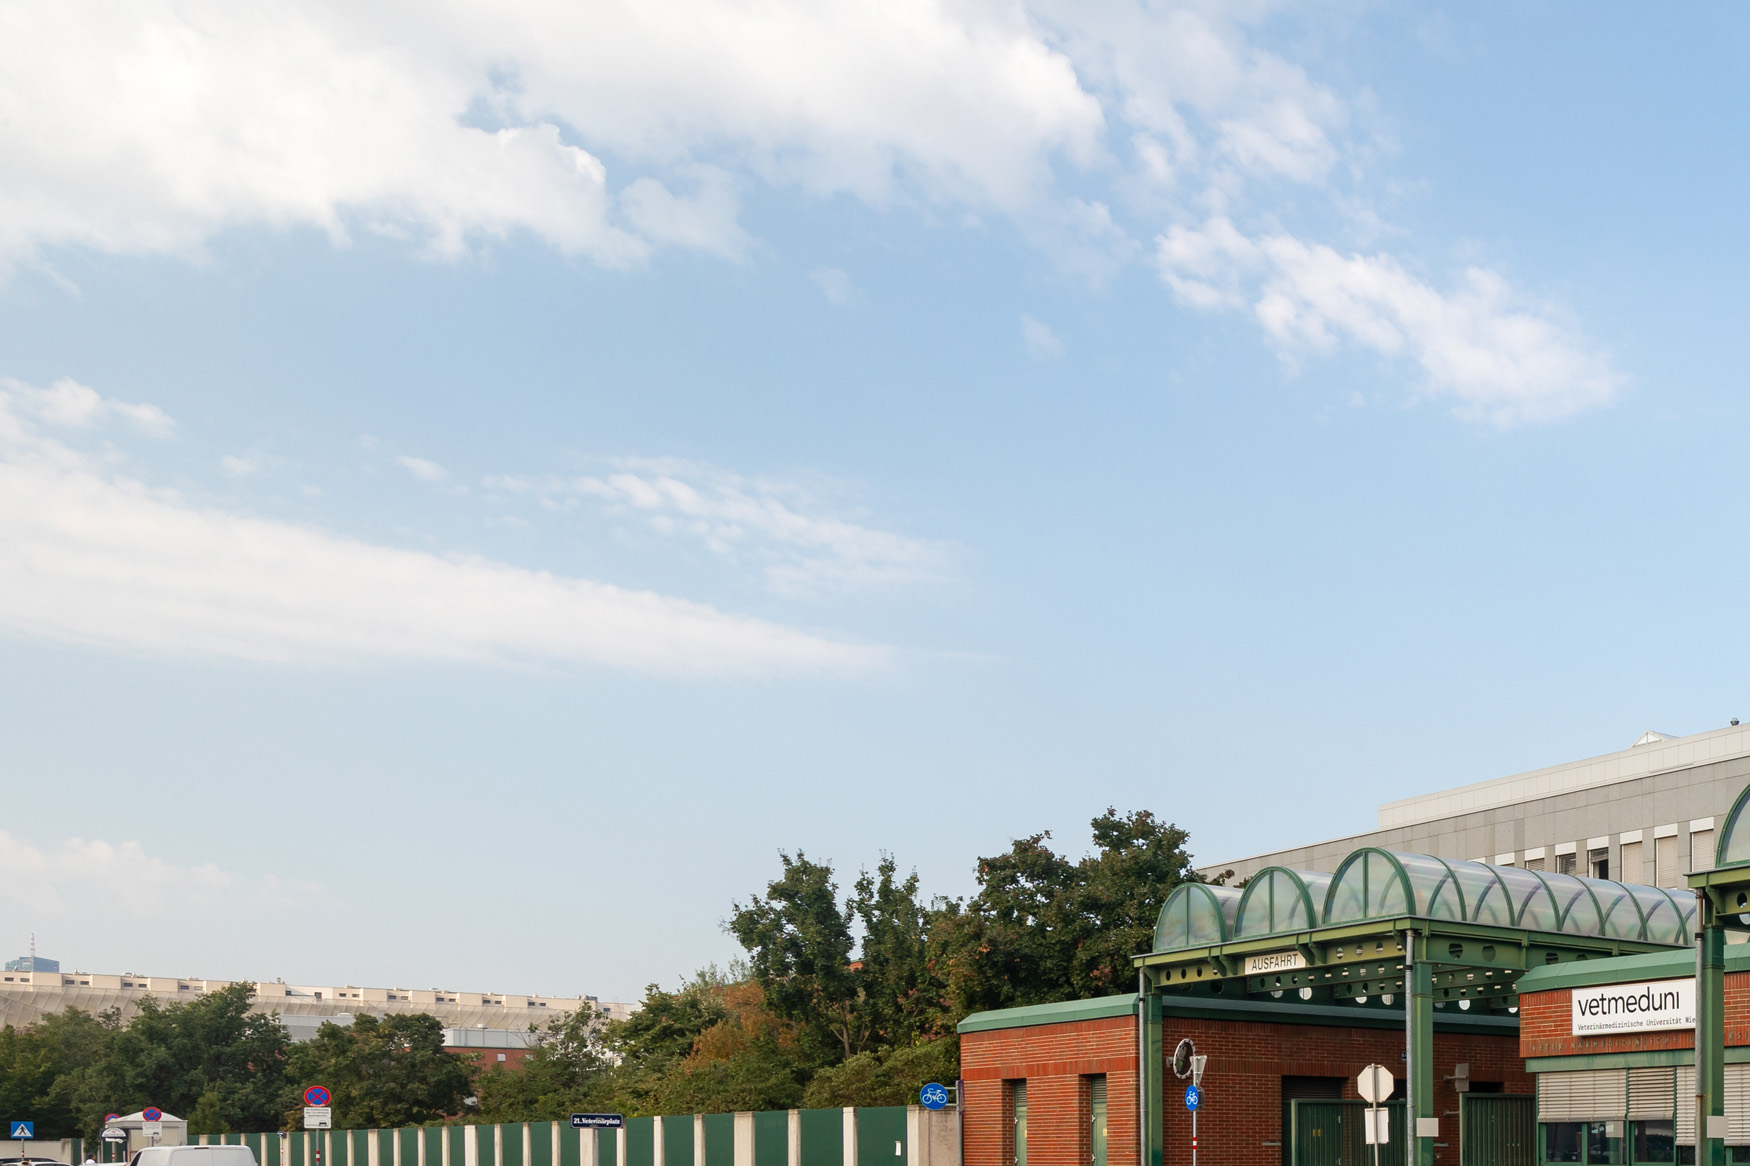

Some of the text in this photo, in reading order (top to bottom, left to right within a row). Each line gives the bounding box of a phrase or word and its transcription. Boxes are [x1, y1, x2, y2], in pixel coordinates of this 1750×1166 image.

[1252, 954, 1298, 970] AUSFAHRT
[1578, 986, 1680, 1016] vetmeduni
[1577, 1016, 1696, 1031] Veterinärmedizinische Universität Wie
